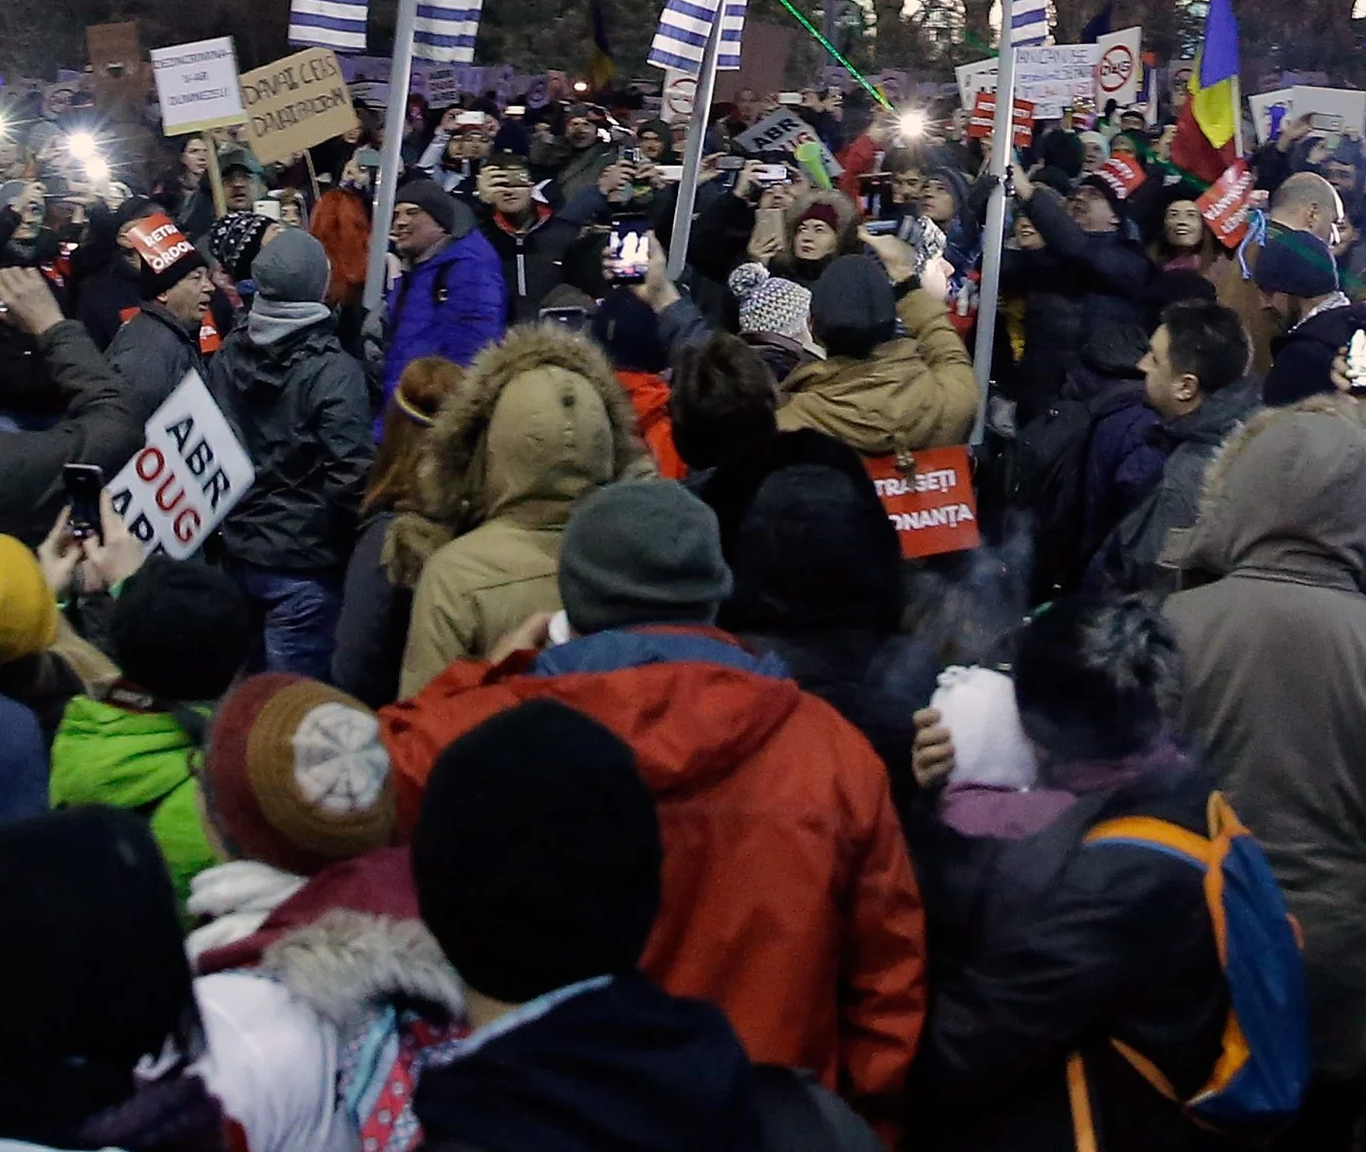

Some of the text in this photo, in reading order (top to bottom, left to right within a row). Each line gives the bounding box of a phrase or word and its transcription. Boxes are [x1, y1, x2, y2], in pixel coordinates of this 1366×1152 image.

[753, 117, 800, 149] ABR
[135, 447, 201, 544] OUG
[165, 415, 232, 515] ABR
